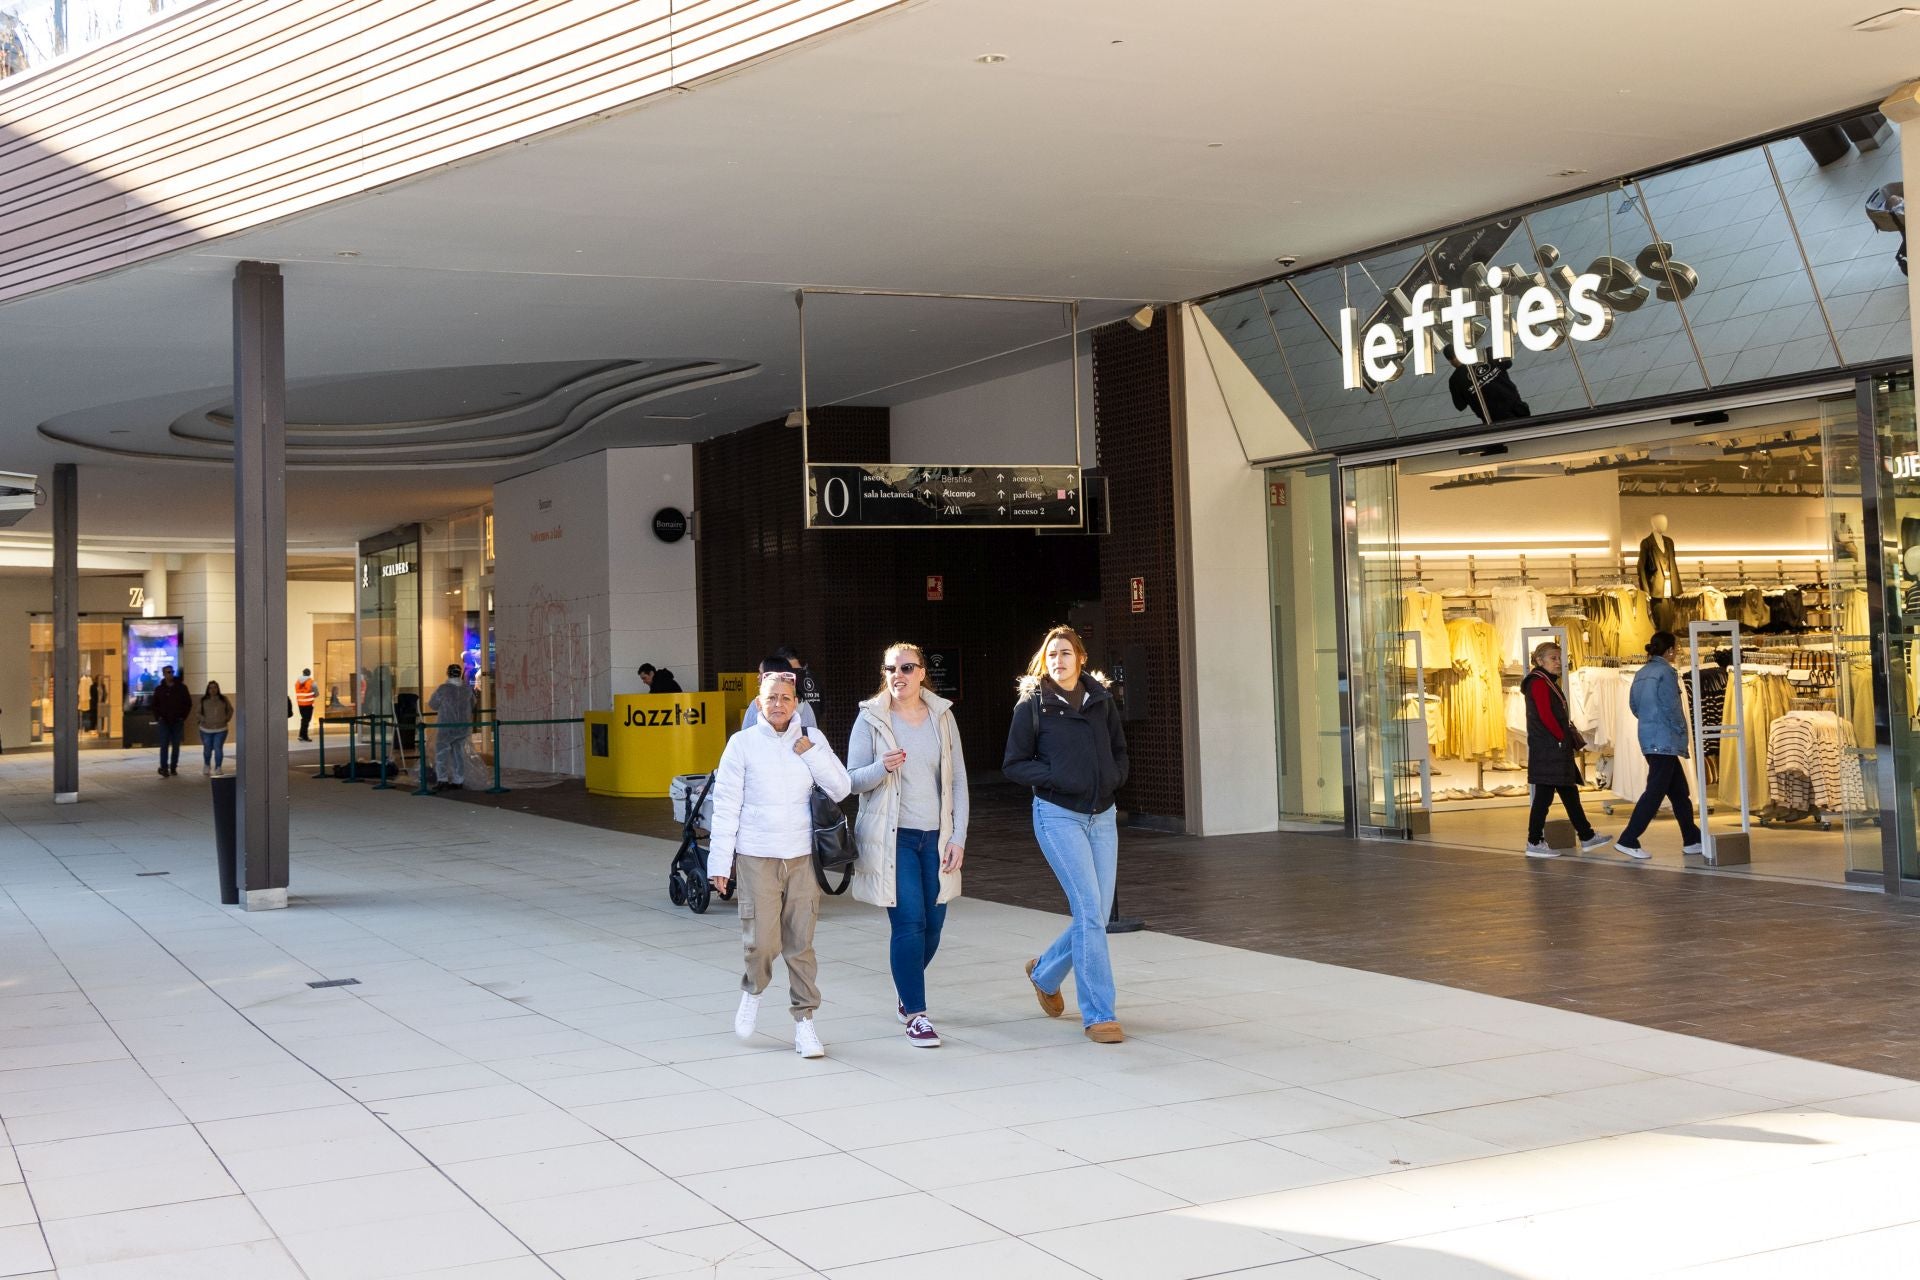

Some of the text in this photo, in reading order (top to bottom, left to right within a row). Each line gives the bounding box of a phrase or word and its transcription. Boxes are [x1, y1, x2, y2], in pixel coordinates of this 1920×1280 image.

[1340, 266, 1609, 390] lefties
[941, 475, 973, 483] Bershka
[863, 490, 914, 498] sala lactancia
[942, 489, 976, 499] Alcampo
[1013, 490, 1042, 500] parking
[1039, 507, 1045, 515] 2
[656, 520, 683, 528] Bonaire
[382, 561, 408, 577] SCALPERS
[623, 702, 706, 727] Jazztel
